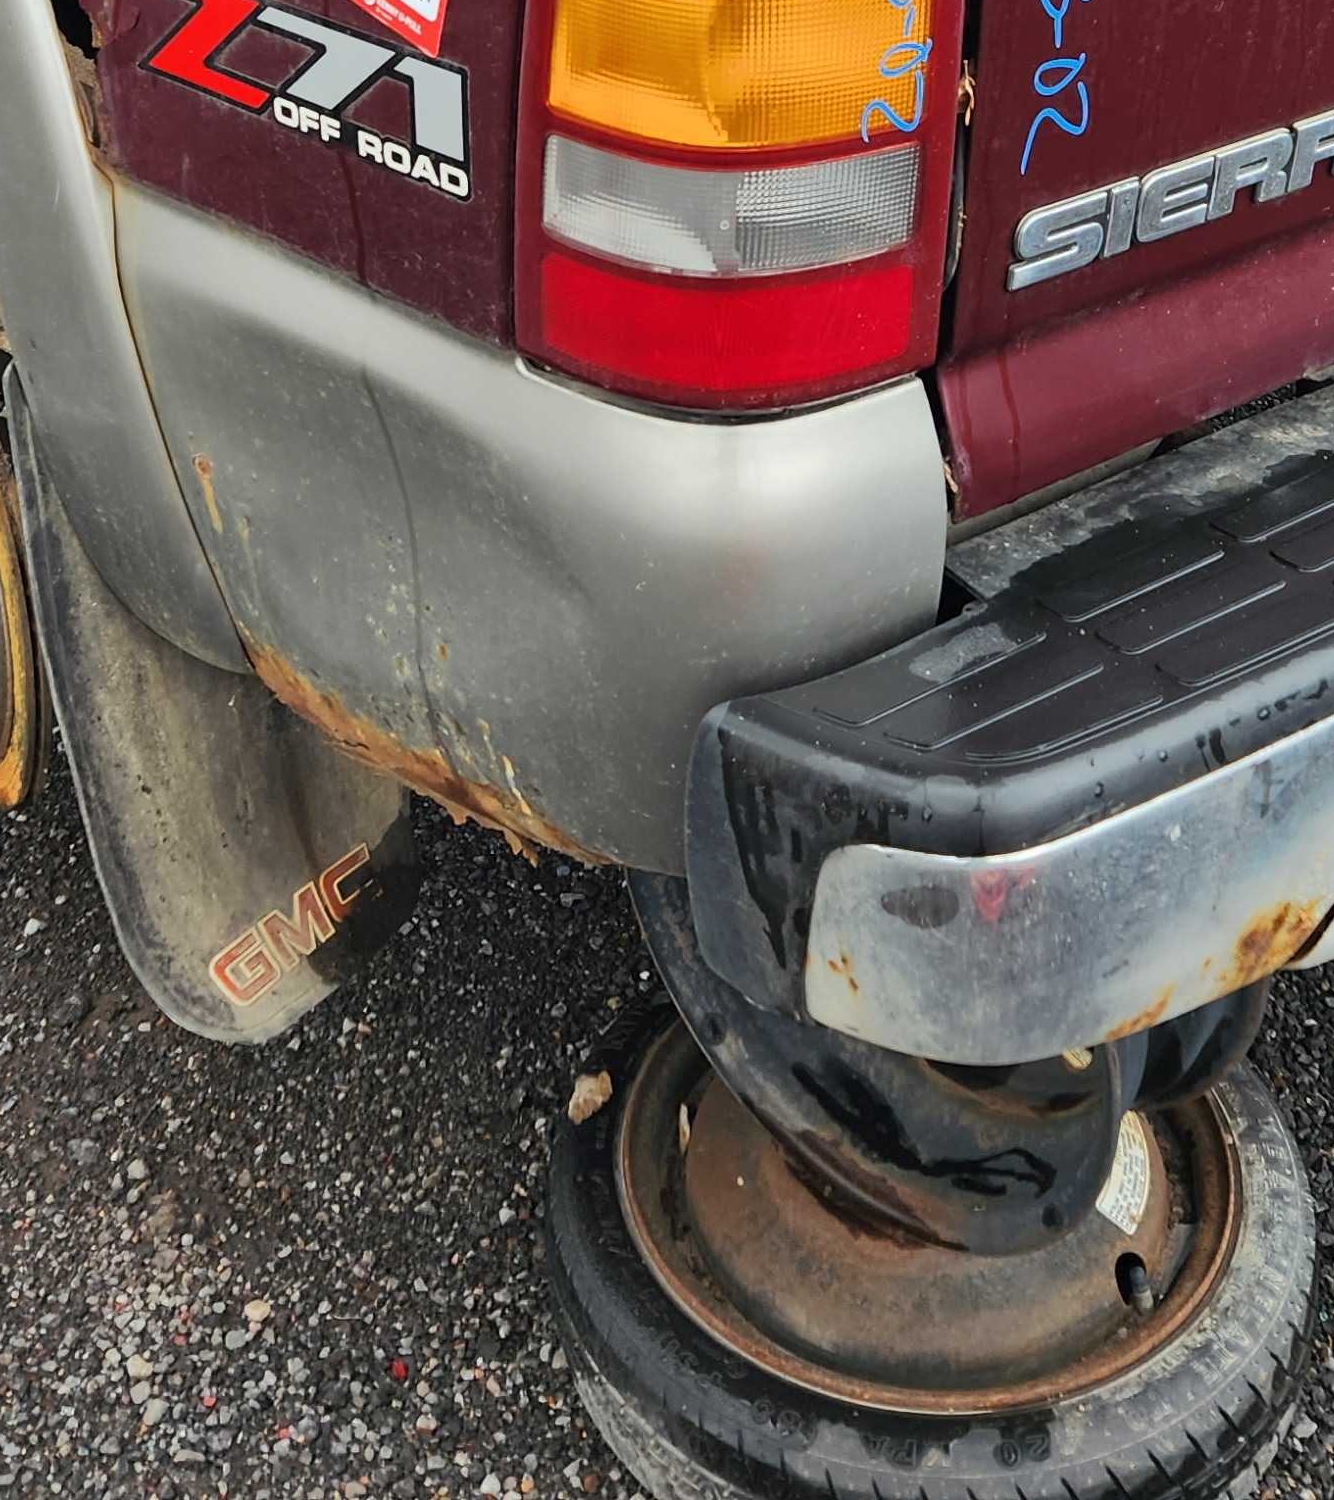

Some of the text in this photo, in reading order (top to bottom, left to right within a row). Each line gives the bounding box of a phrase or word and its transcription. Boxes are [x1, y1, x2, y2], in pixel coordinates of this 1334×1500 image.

[272, 96, 470, 199] OFF ROAD
[209, 843, 377, 1006] GMC
